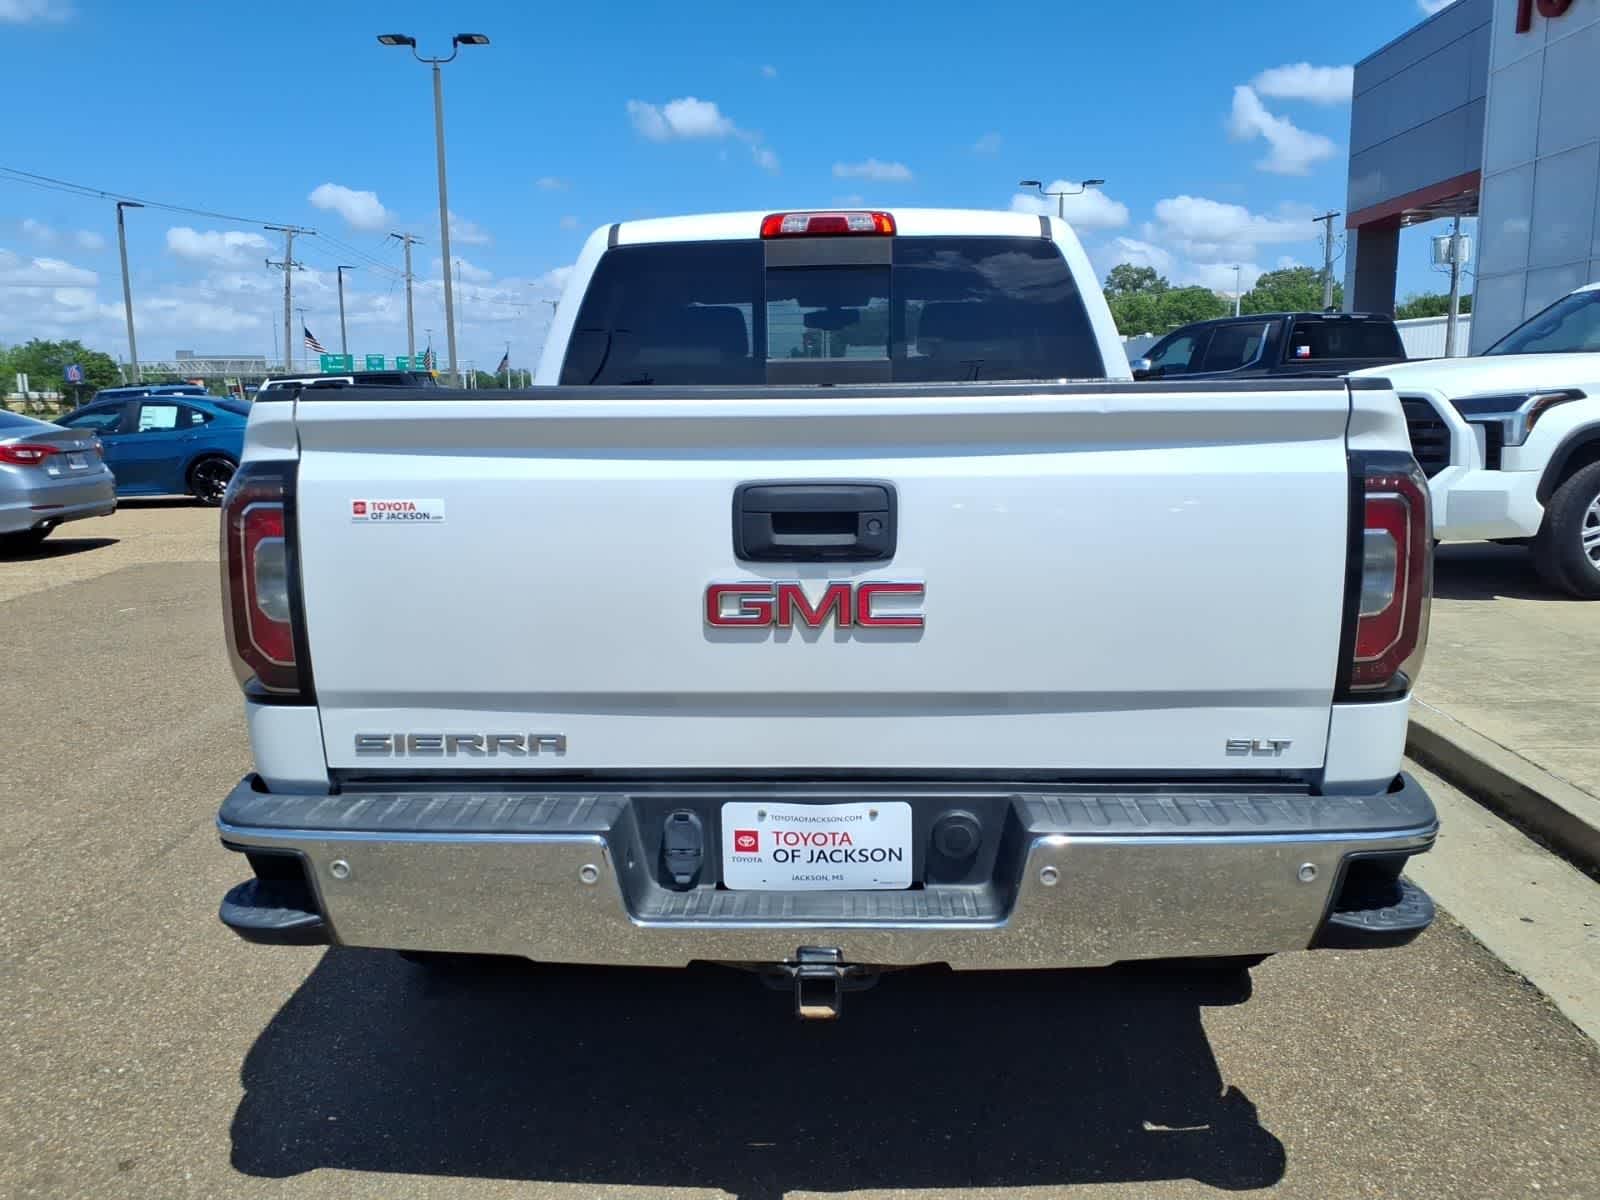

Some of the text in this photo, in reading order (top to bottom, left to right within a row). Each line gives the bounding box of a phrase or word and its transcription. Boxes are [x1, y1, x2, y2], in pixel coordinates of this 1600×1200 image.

[371, 502, 416, 511] TOYOTA
[370, 512, 385, 520] OF
[705, 581, 925, 629] GMC
[355, 733, 567, 757] SIERRA
[1225, 739, 1293, 757] SLT
[770, 814, 863, 824] TOYOTAOFJACKSON.COM
[772, 831, 853, 847] TOYOTA
[772, 847, 903, 864] OF JACKSON
[791, 873, 844, 882] JACKSON, MS
